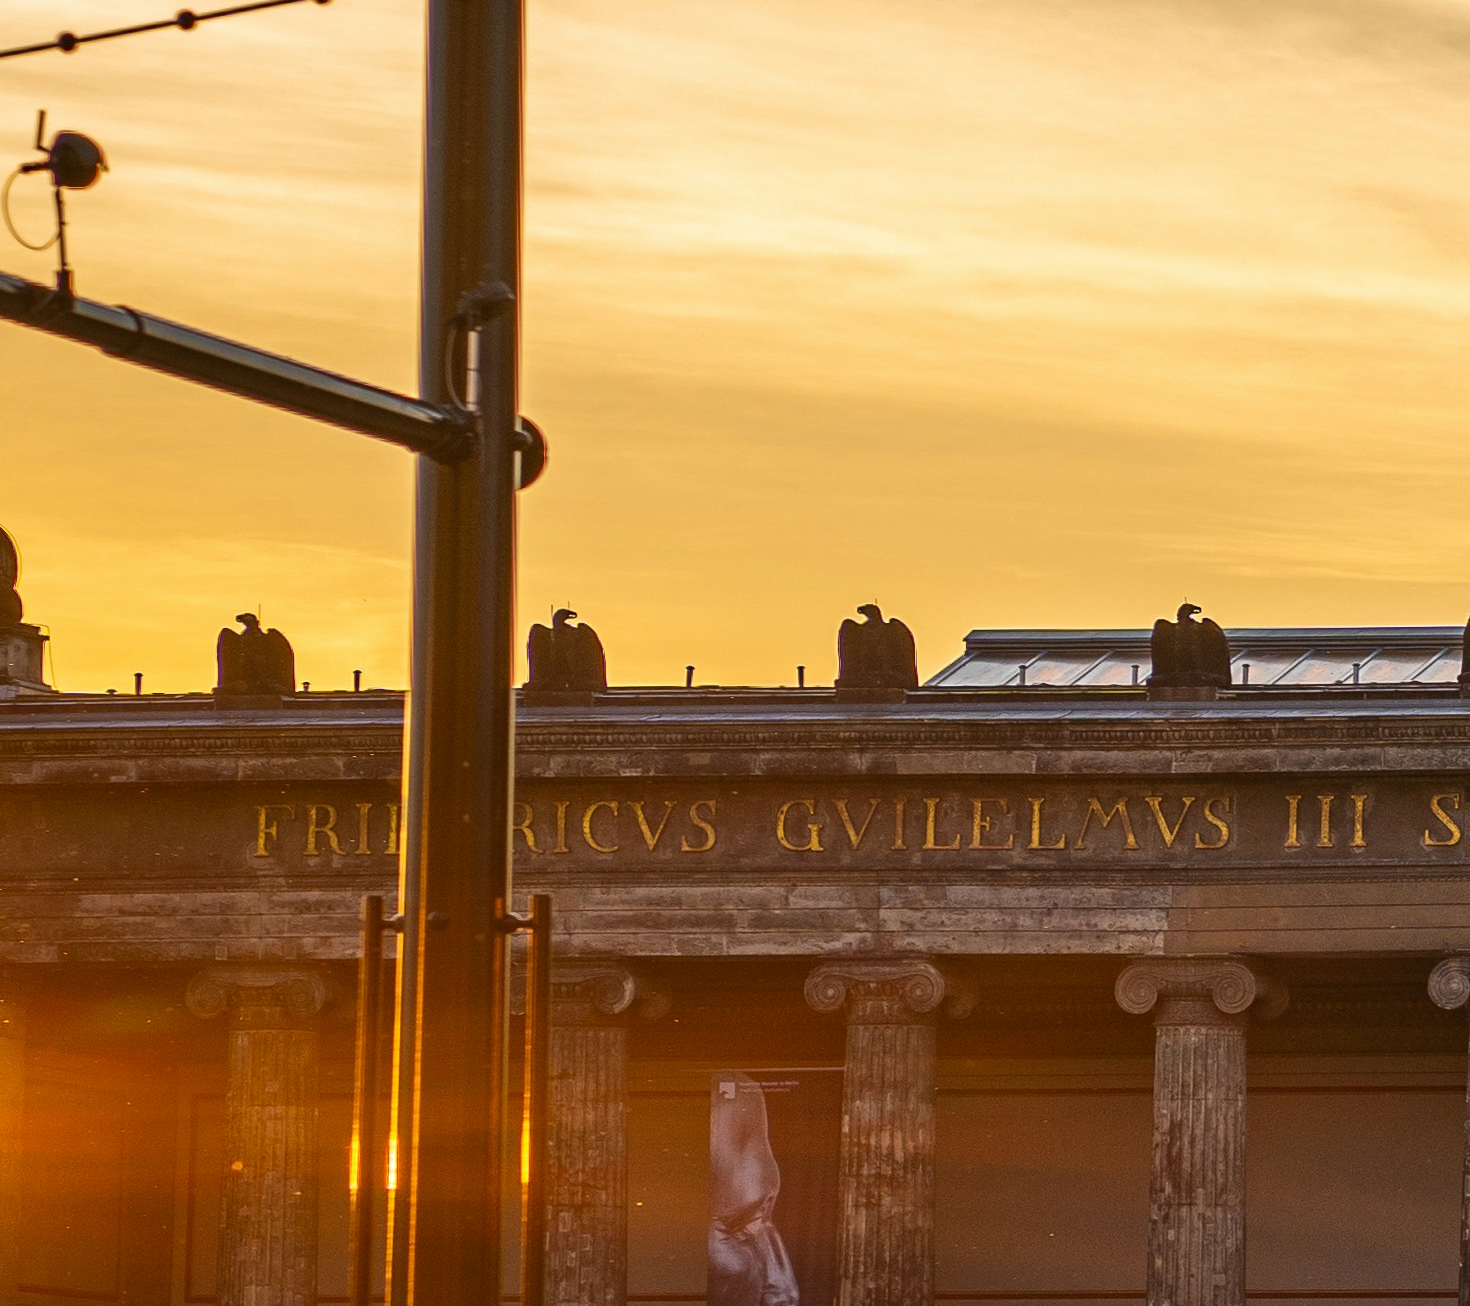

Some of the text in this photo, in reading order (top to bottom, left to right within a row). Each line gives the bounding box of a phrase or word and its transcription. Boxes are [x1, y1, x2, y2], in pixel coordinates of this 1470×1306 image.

[253, 799, 718, 856] FRIRICVS
[776, 794, 1232, 852] GVILELMVS
[1284, 794, 1368, 848] III
